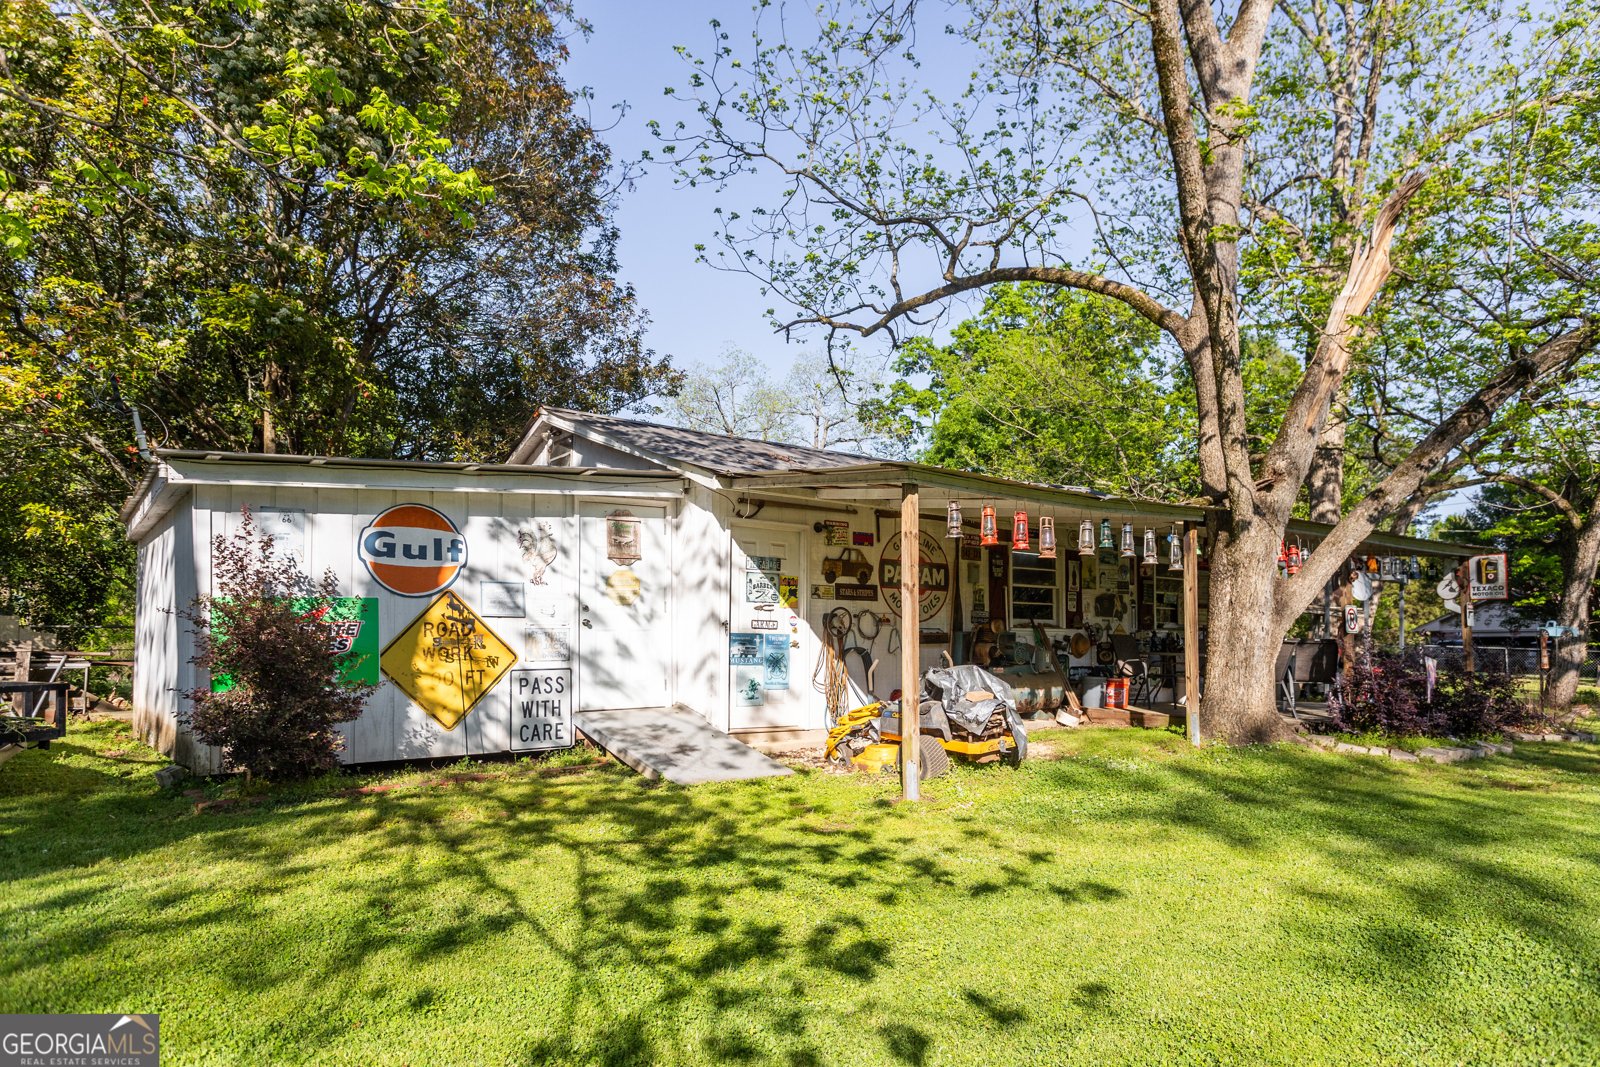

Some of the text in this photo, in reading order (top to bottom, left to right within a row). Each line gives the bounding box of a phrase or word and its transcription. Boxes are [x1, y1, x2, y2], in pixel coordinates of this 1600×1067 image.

[364, 530, 463, 562] Gulf
[922, 594, 941, 614] OILS
[423, 621, 472, 638] ROAD
[465, 669, 485, 685] FT
[519, 676, 564, 695] PASS
[521, 699, 561, 718] WITH
[519, 722, 564, 742] CARE
